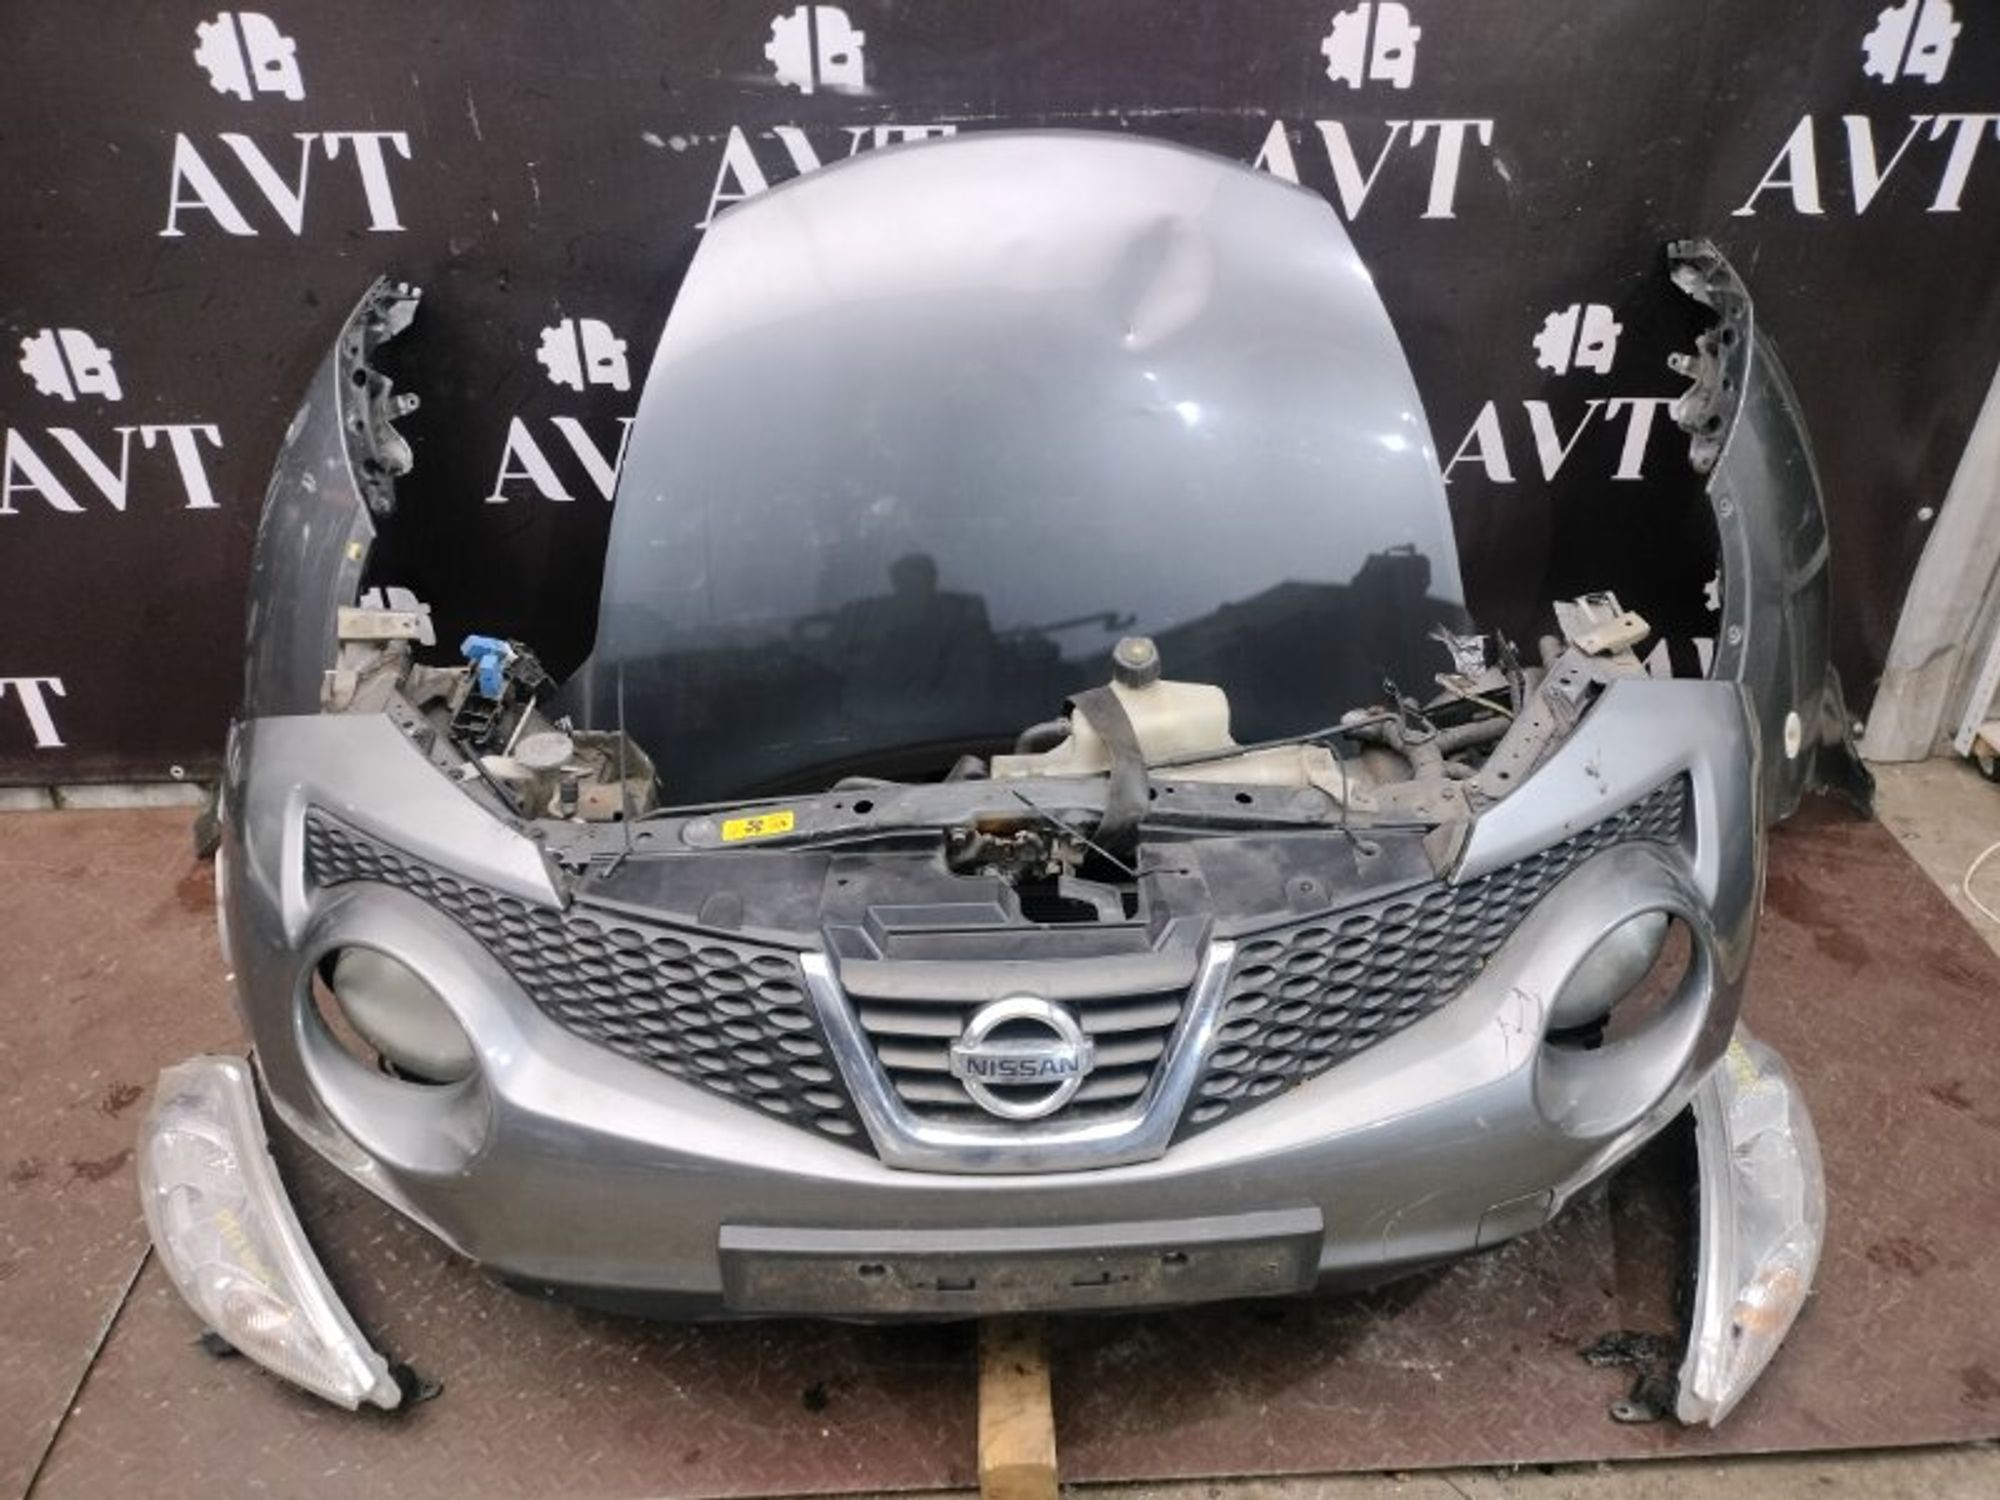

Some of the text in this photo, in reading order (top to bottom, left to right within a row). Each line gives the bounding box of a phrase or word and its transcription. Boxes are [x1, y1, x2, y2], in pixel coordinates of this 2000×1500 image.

[158, 131, 411, 236] AVT
[1731, 113, 2000, 216] AVT
[0, 424, 223, 514] AVT
[1442, 397, 1682, 482] AVT
[966, 1056, 1080, 1077] NISSAN
